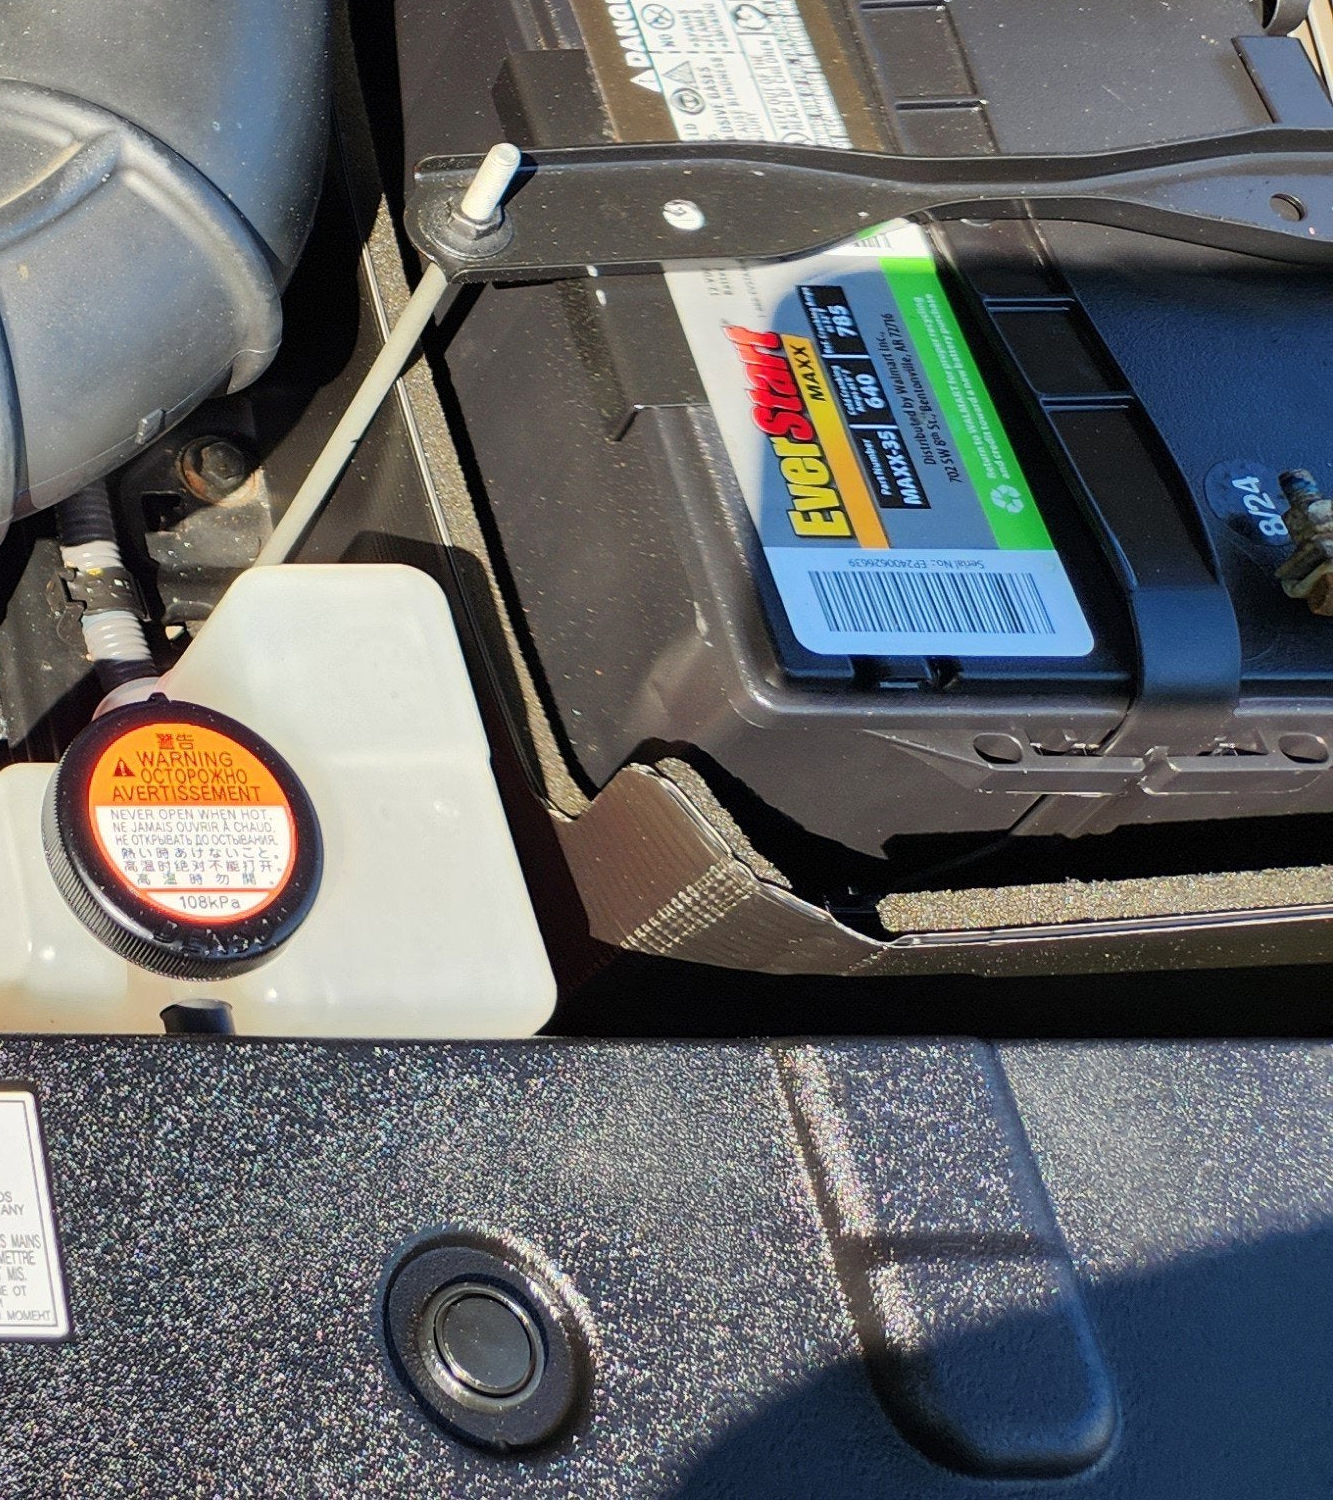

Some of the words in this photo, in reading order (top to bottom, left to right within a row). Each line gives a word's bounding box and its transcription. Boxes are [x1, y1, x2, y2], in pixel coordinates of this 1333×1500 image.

[826, 302, 858, 337] 785
[911, 295, 939, 337] recycling
[923, 292, 950, 333] purchase
[880, 312, 902, 337] 72716
[891, 337, 908, 352] AR
[930, 337, 953, 369] proper
[940, 334, 965, 368] battery
[792, 343, 829, 403] MAXX
[880, 352, 908, 394] Walmart
[898, 353, 933, 411] Bentonville,
[956, 368, 972, 387] new
[853, 371, 886, 409] 640
[898, 395, 915, 408] by
[949, 385, 978, 433] WALMART
[966, 396, 990, 430] toward
[723, 322, 854, 540] EverStart
[903, 409, 937, 465] Distributed
[981, 431, 1002, 458] credit
[860, 437, 884, 475] Number
[936, 449, 954, 464] SW
[974, 446, 998, 478] Return
[876, 429, 923, 504] MAXX-35
[944, 466, 962, 482] 702
[993, 460, 1011, 478] and
[875, 477, 892, 495] Part
[1232, 476, 1289, 536] 8/24
[955, 558, 985, 569] Serial
[156, 733, 194, 750] 警告
[136, 751, 233, 767] WARNING
[140, 768, 248, 784] ОСТОРОЖНО
[113, 785, 260, 801] AVERTISSEMENT
[110, 809, 154, 820] NEVER
[159, 809, 194, 820] OPEN
[197, 809, 236, 820] WHEN
[241, 809, 273, 820] HOT.
[113, 822, 127, 833] NE
[131, 822, 173, 833] JAMAIS
[176, 822, 219, 833] OUVRIR
[233, 822, 276, 833] CHAUD.
[115, 835, 129, 846] НЕ
[131, 835, 192, 846] ОТКРЫВАТЬ
[195, 835, 209, 846] ДО
[211, 835, 278, 846] ОСТЫВАНИЯ.
[180, 896, 241, 909] 108kPa
[0, 1203, 25, 1215] ANY
[10, 1233, 41, 1249] MAINS
[6, 1266, 27, 1281] MIS.
[12, 1285, 27, 1296] ОТ
[6, 1310, 51, 1321] МОМЕНТ
